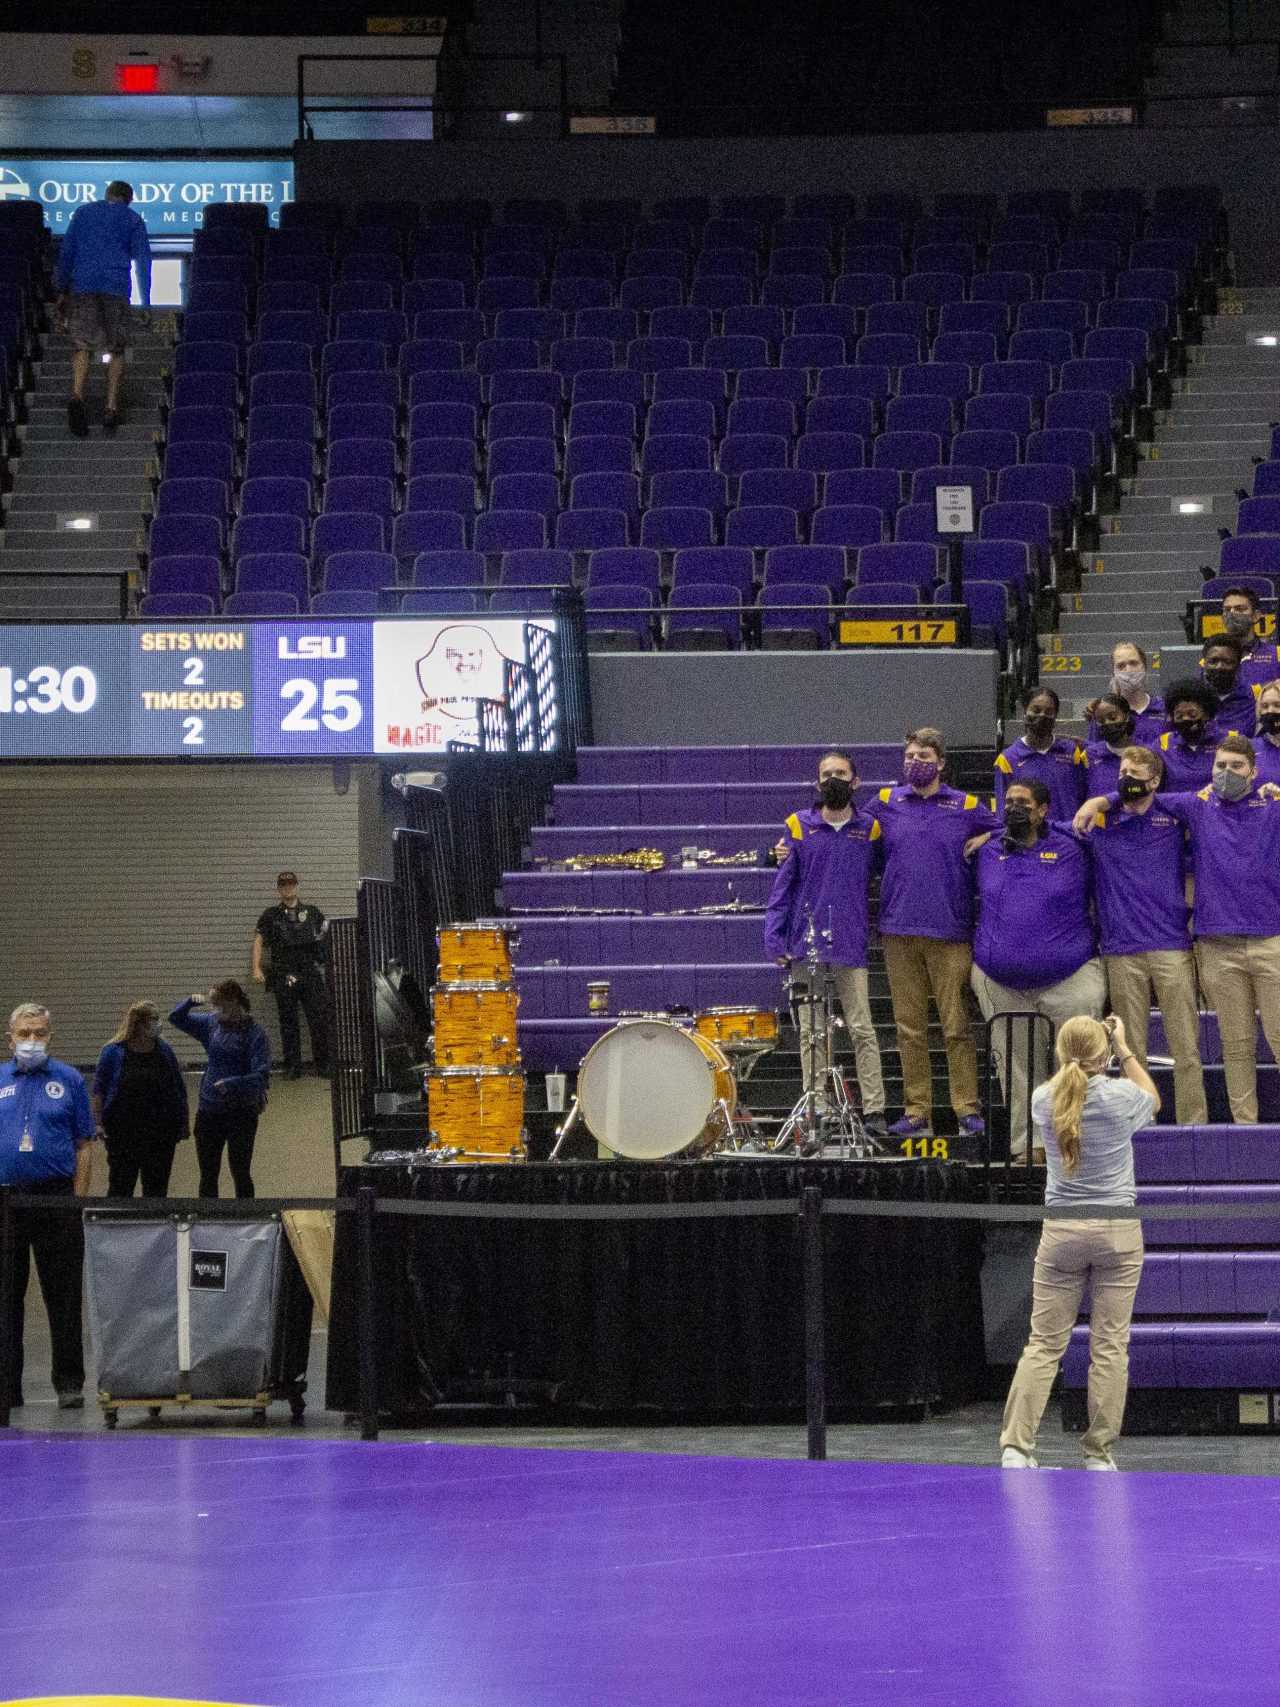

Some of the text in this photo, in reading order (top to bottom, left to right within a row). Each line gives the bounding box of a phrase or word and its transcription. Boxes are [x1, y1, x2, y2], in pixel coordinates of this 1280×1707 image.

[39, 180, 98, 203] OUR
[181, 183, 215, 203] OF
[220, 183, 274, 203] THE
[141, 632, 243, 652] SETS WON
[890, 623, 944, 641] 117
[279, 637, 346, 659] LSU
[183, 658, 205, 685] 2
[1042, 656, 1082, 672] 223
[142, 691, 244, 711] TIMEOUTS
[280, 679, 363, 732] 25
[183, 718, 205, 745] 2
[900, 1137, 949, 1160] 118
